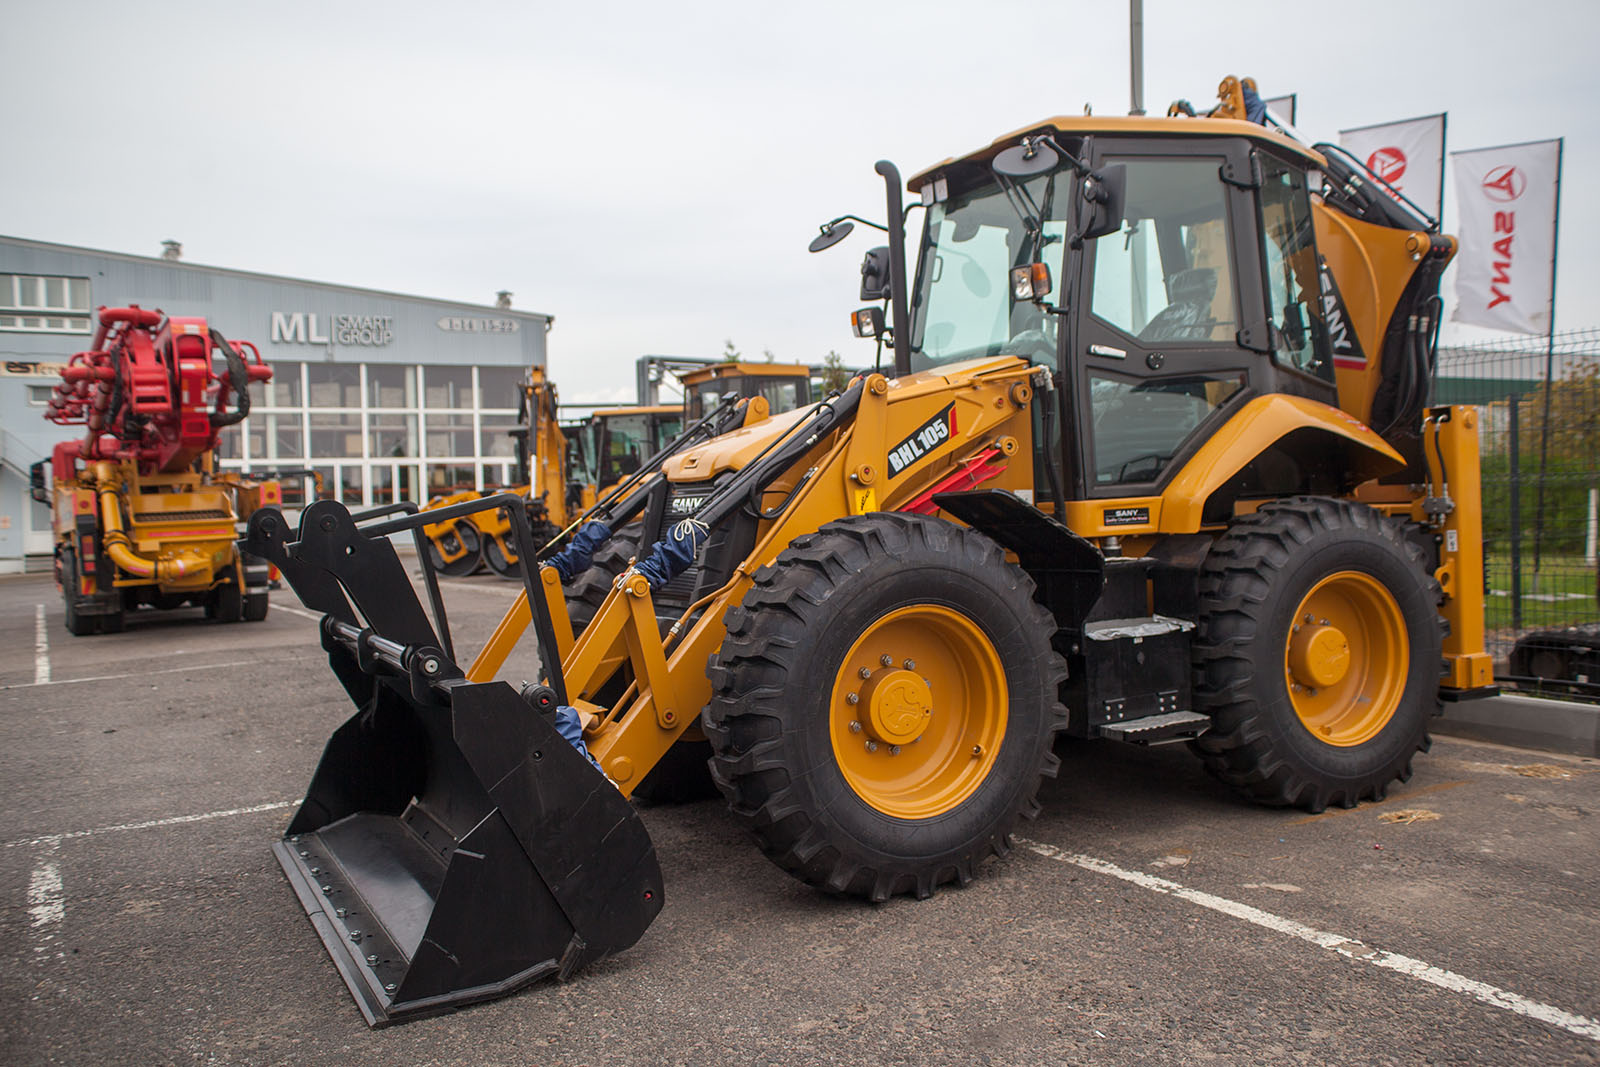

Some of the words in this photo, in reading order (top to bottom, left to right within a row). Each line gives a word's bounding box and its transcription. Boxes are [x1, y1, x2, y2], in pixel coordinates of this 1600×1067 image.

[271, 311, 328, 343] ML
[338, 314, 392, 329] SMART
[338, 329, 392, 345] GROUP
[1115, 509, 1139, 517] SANY
